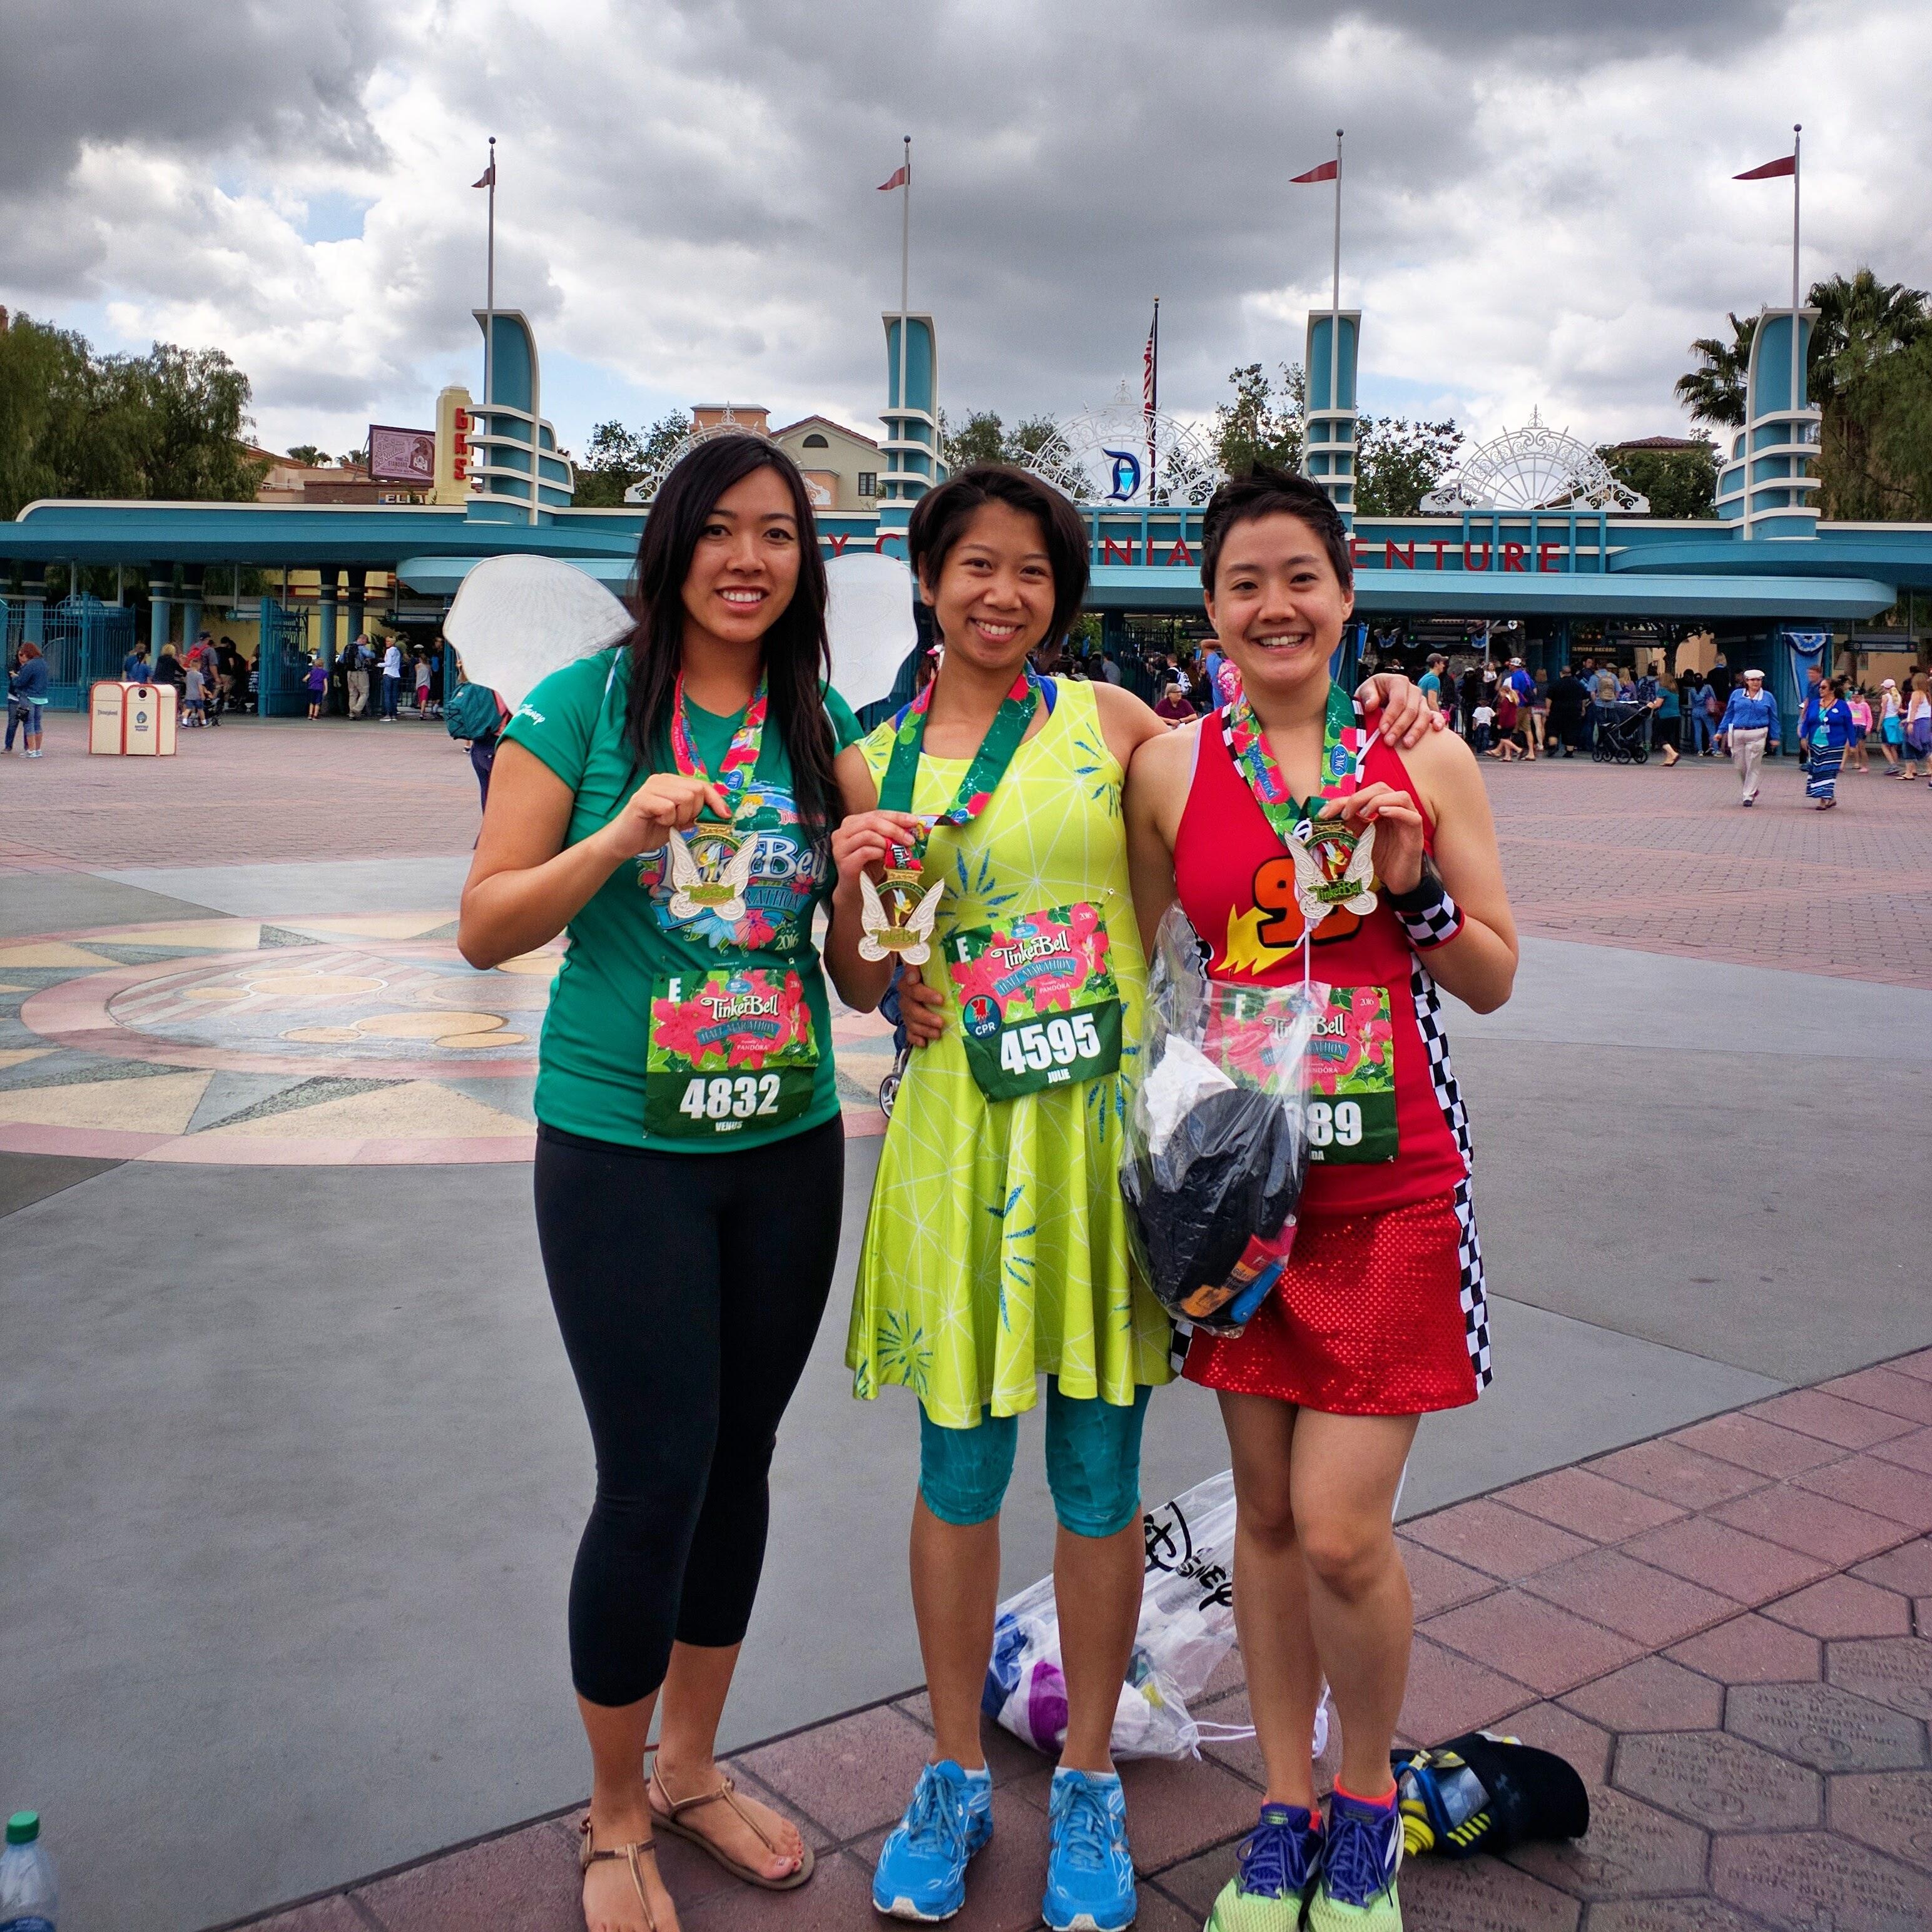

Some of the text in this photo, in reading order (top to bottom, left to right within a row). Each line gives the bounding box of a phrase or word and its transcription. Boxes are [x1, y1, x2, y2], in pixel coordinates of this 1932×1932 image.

[454, 407, 469, 480] GAS
[385, 494, 424, 504] ELIT
[1349, 537, 1561, 572] ENTURE
[1334, 748, 1345, 771] 2016
[743, 888, 804, 912] RATHON
[1307, 877, 1365, 903] TinkerBell
[775, 933, 800, 951] 2016
[956, 936, 971, 963] E
[990, 930, 1071, 970] TinkerBell
[668, 977, 681, 1003] E
[1039, 983, 1072, 995] PANDORA
[700, 993, 779, 1022] TinkerBell
[975, 1021, 996, 1035] CPR
[1001, 1012, 1101, 1075] 4595
[1047, 1067, 1071, 1084] JULIE
[679, 1074, 781, 1119] 4832
[715, 1121, 744, 1132] VENUS
[1306, 1101, 1363, 1146] 89
